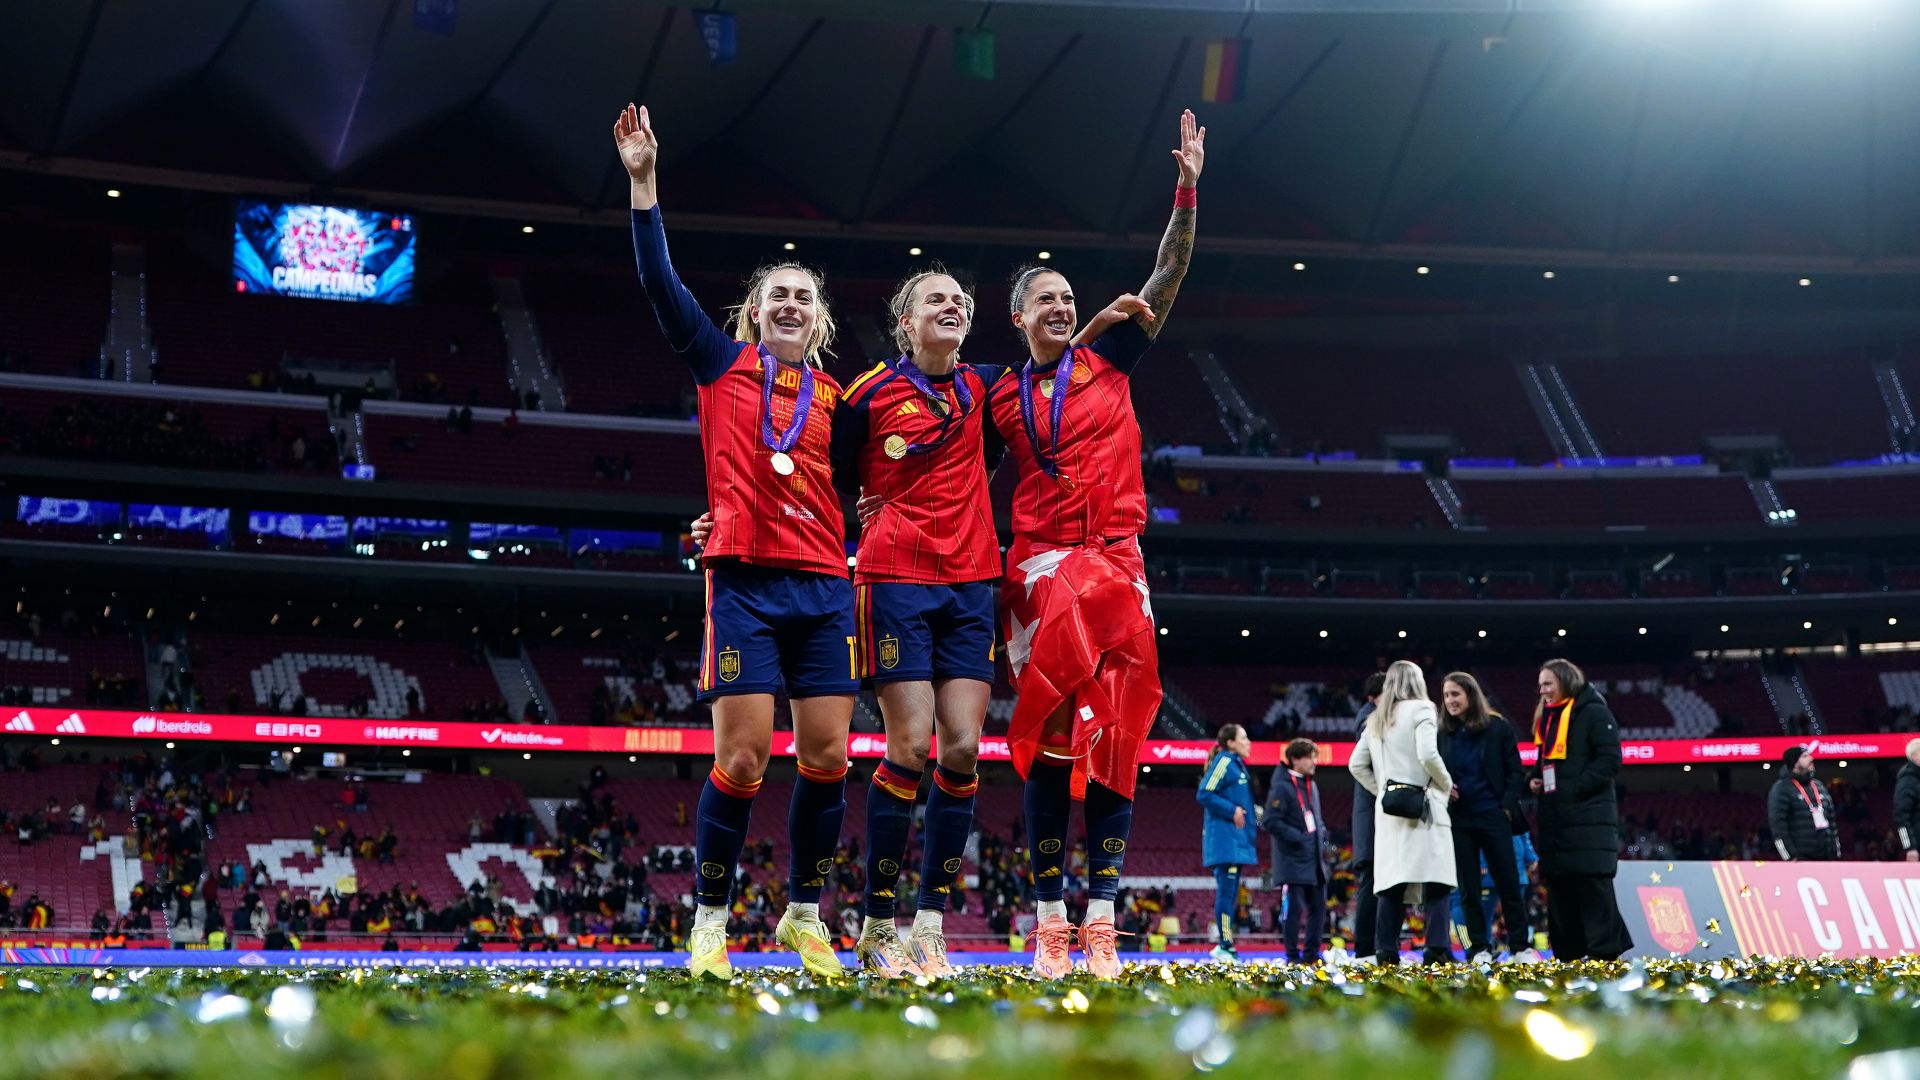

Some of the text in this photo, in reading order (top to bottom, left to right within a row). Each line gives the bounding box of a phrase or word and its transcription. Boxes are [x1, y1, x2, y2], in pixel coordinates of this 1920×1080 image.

[273, 266, 377, 296] CAMPEONAS
[846, 636, 857, 680] 1
[156, 719, 212, 734] Iberdrola
[255, 722, 322, 737] EBRO
[375, 726, 439, 741] MAPFRE
[624, 728, 682, 752] MADRID
[1702, 743, 1760, 756] MAPFRE
